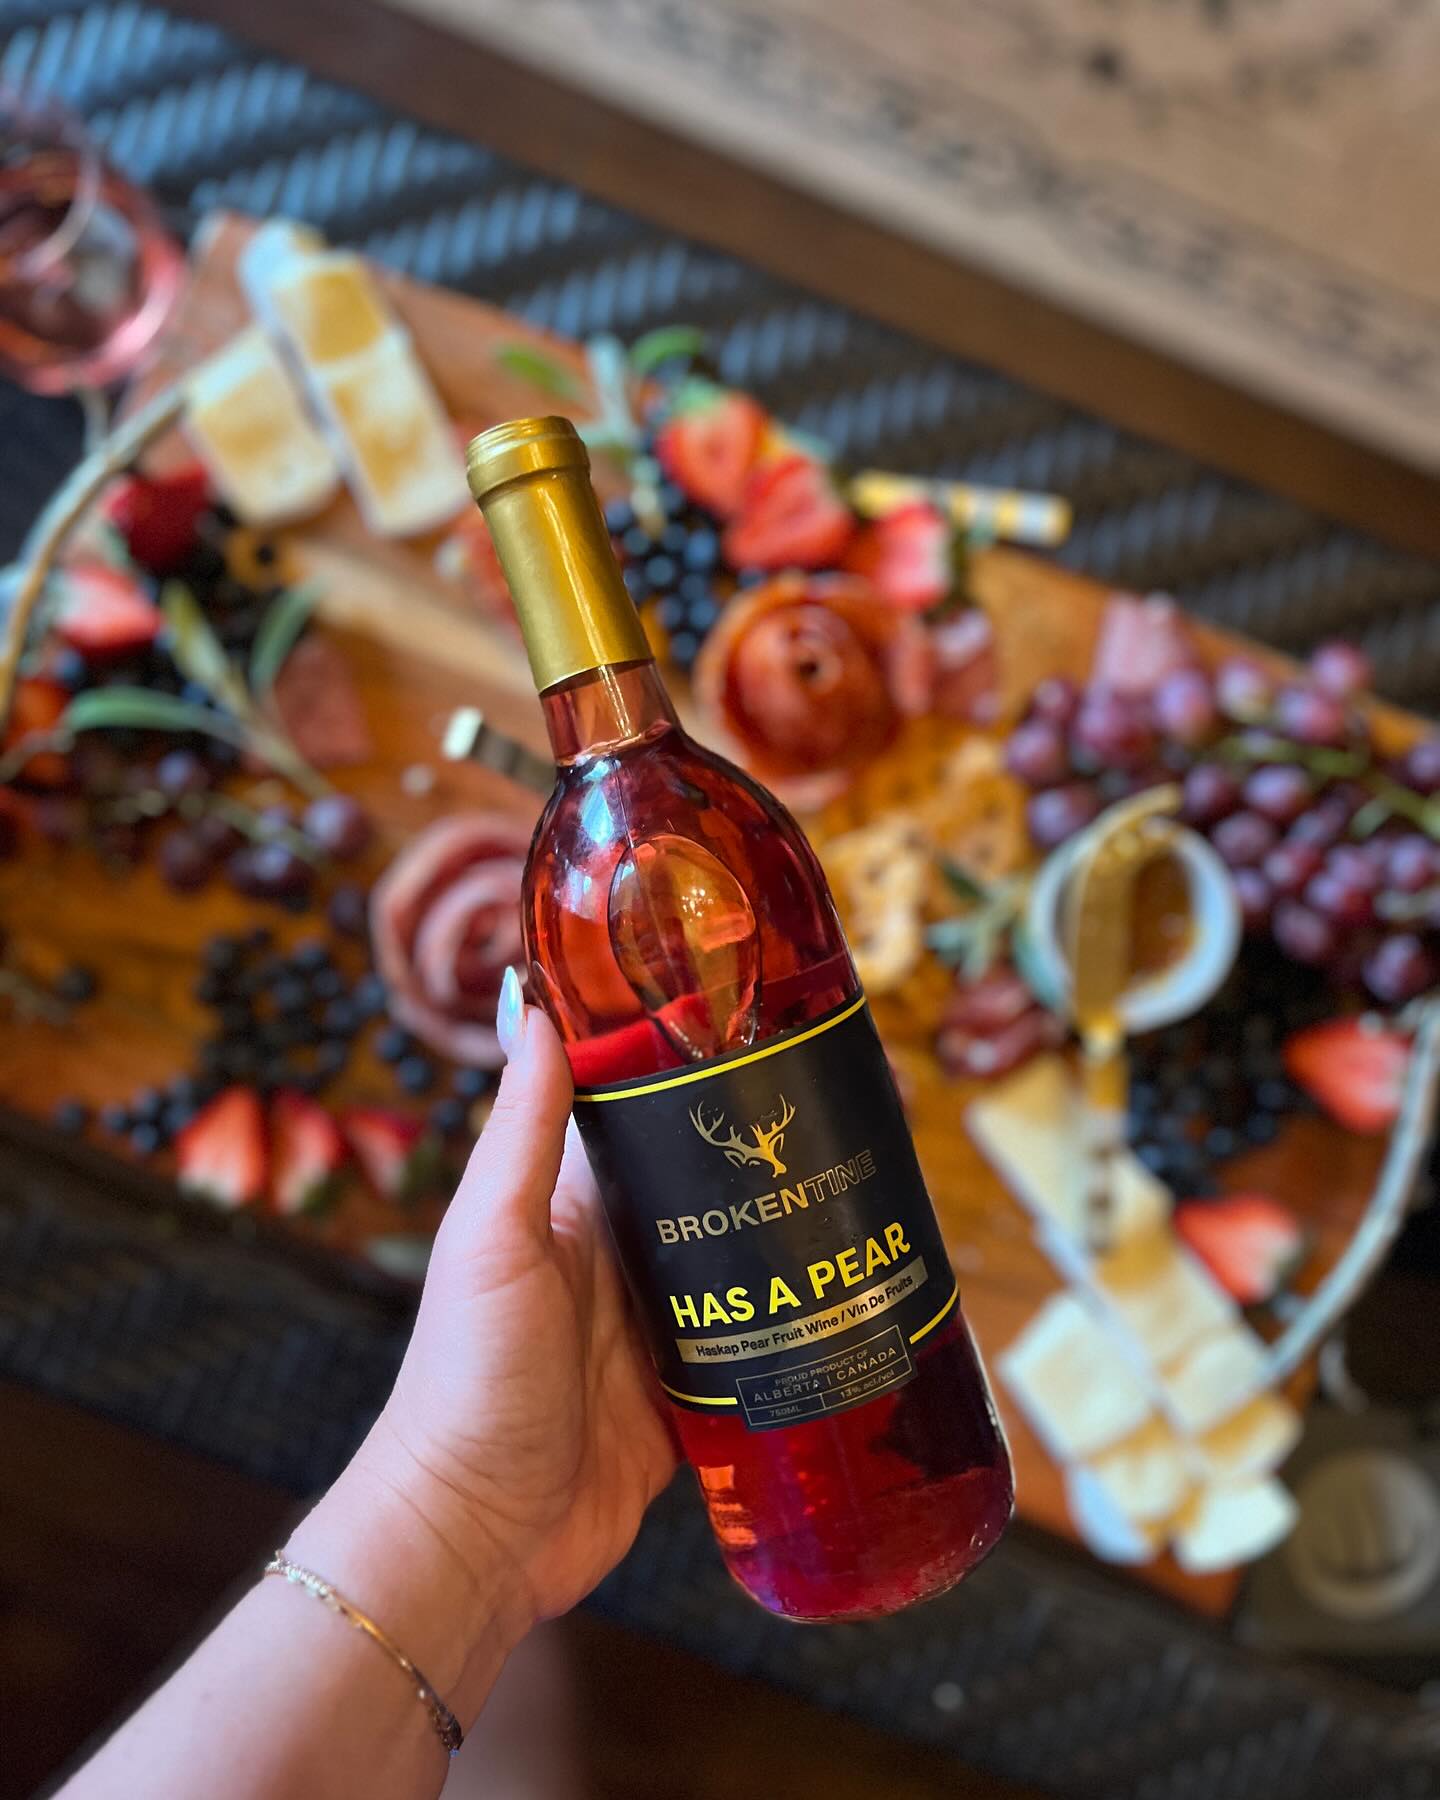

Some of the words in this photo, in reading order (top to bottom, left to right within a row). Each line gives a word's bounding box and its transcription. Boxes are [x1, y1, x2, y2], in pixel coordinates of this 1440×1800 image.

[669, 1286, 756, 1328] HAS
[768, 1276, 801, 1314] A
[807, 1222, 911, 1299] PEAR
[695, 1342, 740, 1357] Haskap
[741, 1335, 770, 1352] Pear
[772, 1328, 804, 1345] Fruit
[804, 1317, 839, 1336] Wine
[849, 1303, 868, 1319] Vin
[869, 1294, 885, 1309] De
[886, 1275, 914, 1300] Fruits
[754, 1378, 820, 1403] ALBERTA
[836, 1347, 897, 1381] CANADA
[774, 1372, 808, 1387] PROUD
[810, 1354, 856, 1378] PRODUCT
[856, 1349, 869, 1361] OF
[769, 1404, 802, 1418] 750ML
